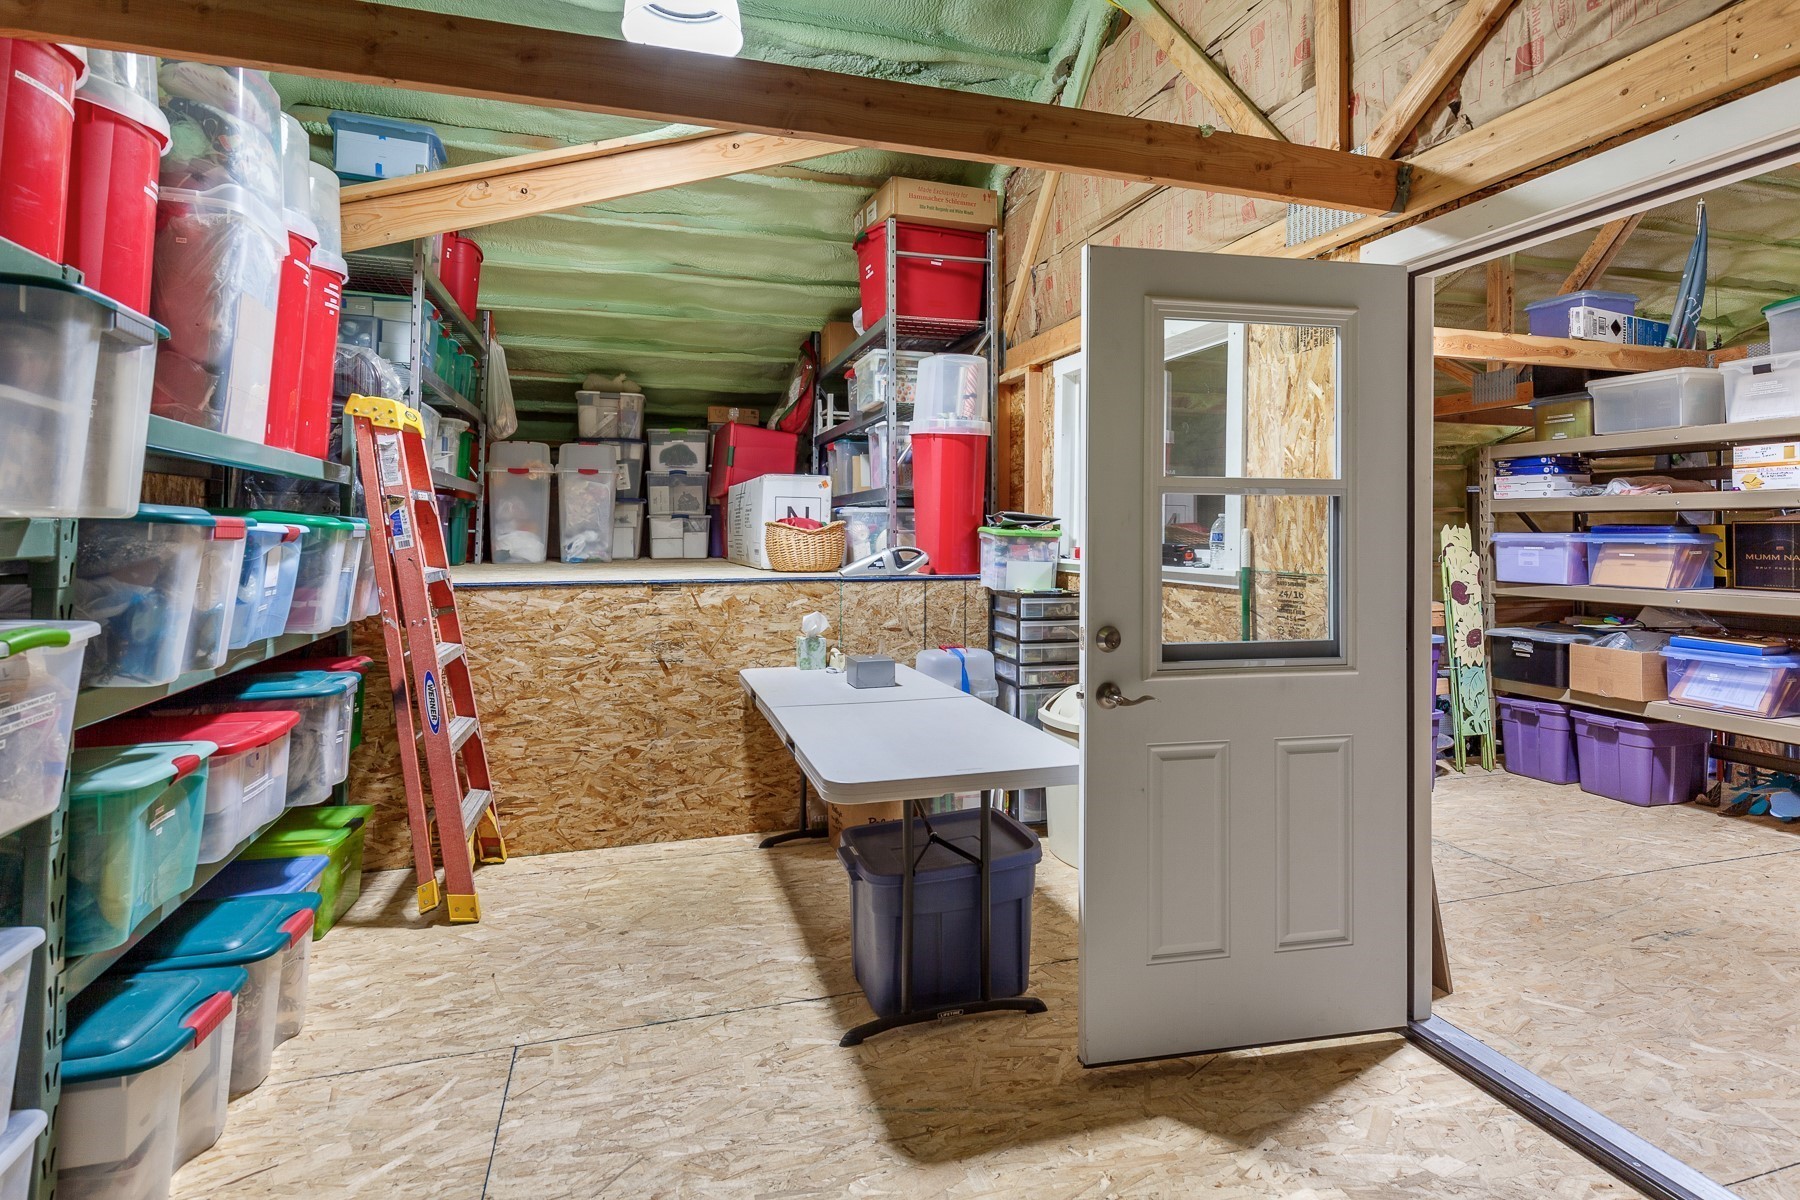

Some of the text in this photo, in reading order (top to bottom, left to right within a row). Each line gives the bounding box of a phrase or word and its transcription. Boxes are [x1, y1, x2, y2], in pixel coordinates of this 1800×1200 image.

[908, 192, 944, 202] Hammacher
[945, 198, 977, 207] Schlemmer
[1745, 553, 1780, 561] MUMM
[1279, 591, 1304, 599] 24/16
[427, 684, 438, 721] WERNER
